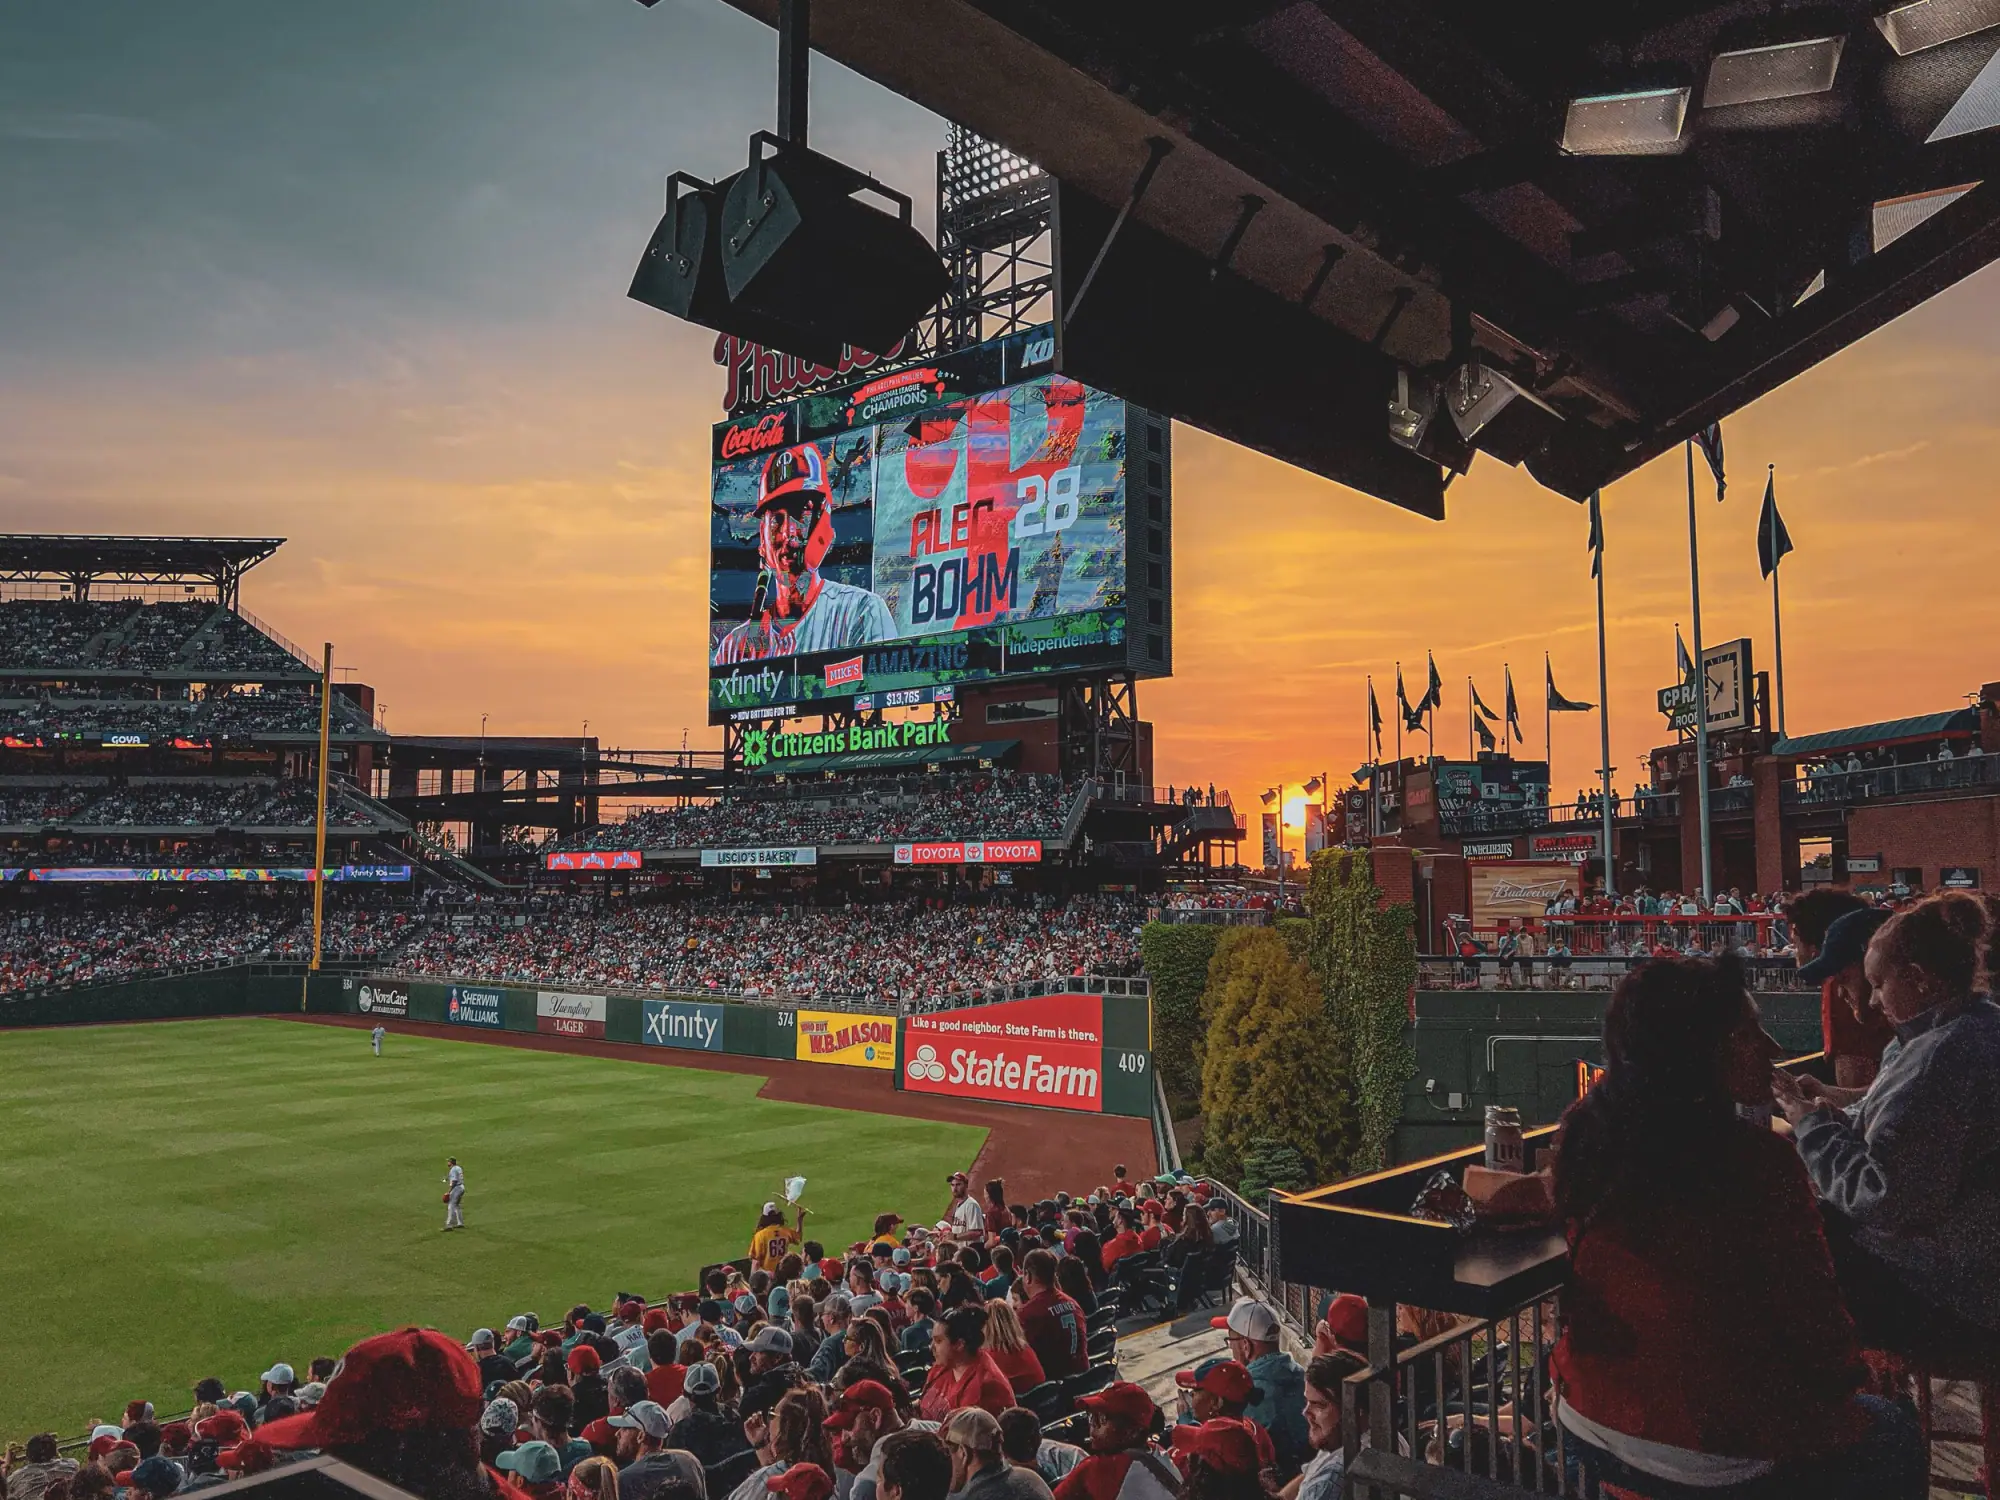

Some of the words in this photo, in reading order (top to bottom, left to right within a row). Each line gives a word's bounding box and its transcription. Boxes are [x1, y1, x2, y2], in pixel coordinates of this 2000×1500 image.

[870, 389, 899, 403] NATIONAL
[899, 384, 920, 394] LEAGUE
[862, 389, 927, 419] CHAMPIONS
[1015, 465, 1081, 539] 28
[909, 497, 994, 558] ALEC
[911, 546, 1020, 625] BOHM
[1009, 631, 1104, 656] Independence
[829, 664, 860, 682] MIKE'S
[866, 643, 969, 676] AMAZING
[718, 665, 784, 704] xfinity
[1663, 690, 1680, 708] CP
[738, 711, 750, 720] NOW
[774, 706, 784, 716] FOR
[785, 705, 796, 715] THE
[771, 728, 845, 758] Citizens
[849, 720, 899, 751] Bank
[903, 715, 951, 746] Park
[717, 851, 757, 864] LISCIO'S
[759, 850, 798, 864] BAKERY
[916, 847, 961, 860] TOYOTA
[988, 845, 1037, 859] TOYOTA
[1495, 884, 1560, 899] Budweiser
[372, 988, 408, 1006] NovaCare
[461, 990, 499, 1008] SHERWIN
[549, 996, 593, 1017] Yuengling
[460, 1006, 498, 1024] WILLIAMS
[777, 1012, 794, 1028] 374
[556, 1019, 584, 1033] LAGER
[647, 1004, 718, 1048] xfinity
[801, 1021, 815, 1032] WHO
[816, 1021, 828, 1032] BUT
[912, 1017, 929, 1029] Like
[931, 1021, 937, 1029] a
[939, 1019, 960, 1033] good
[962, 1021, 1003, 1035] neighbor,
[1005, 1023, 1030, 1036] State
[1032, 1026, 1056, 1039] Farm
[1058, 1028, 1066, 1039] is
[1068, 1029, 1098, 1042] there.
[1118, 1052, 1146, 1074] 409
[769, 1238, 786, 1258] 63
[1061, 1313, 1078, 1354] 7
